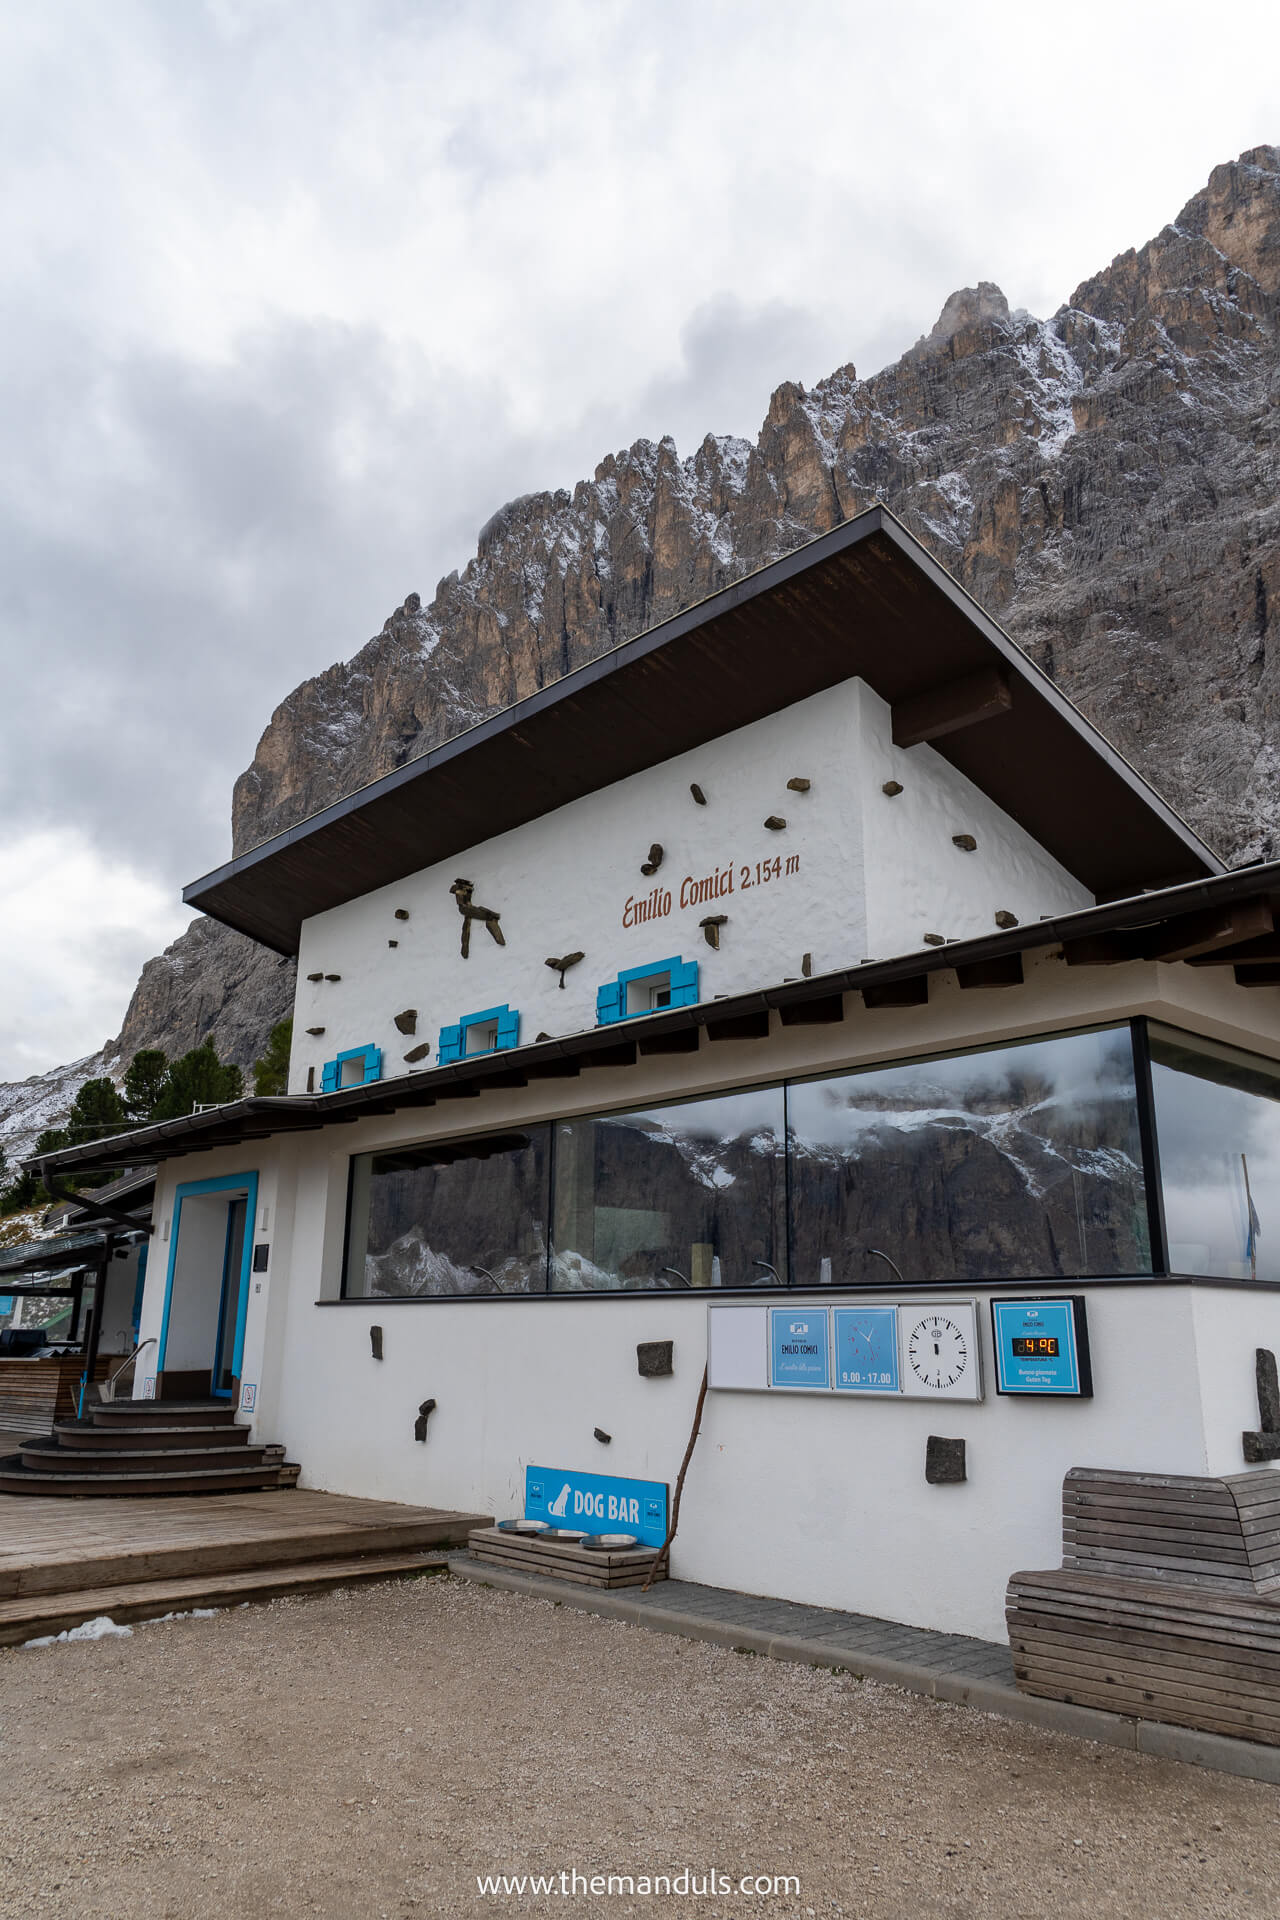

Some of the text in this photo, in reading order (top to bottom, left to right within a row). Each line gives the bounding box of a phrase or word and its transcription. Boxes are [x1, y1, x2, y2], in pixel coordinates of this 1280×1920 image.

[622, 854, 800, 928] Emilio Comici 2.154 m
[781, 1344, 818, 1355] EMILIO COMICI
[842, 1371, 861, 1383] 9.00
[868, 1372, 891, 1384] 17.00
[574, 1489, 640, 1524] DOG BAR
